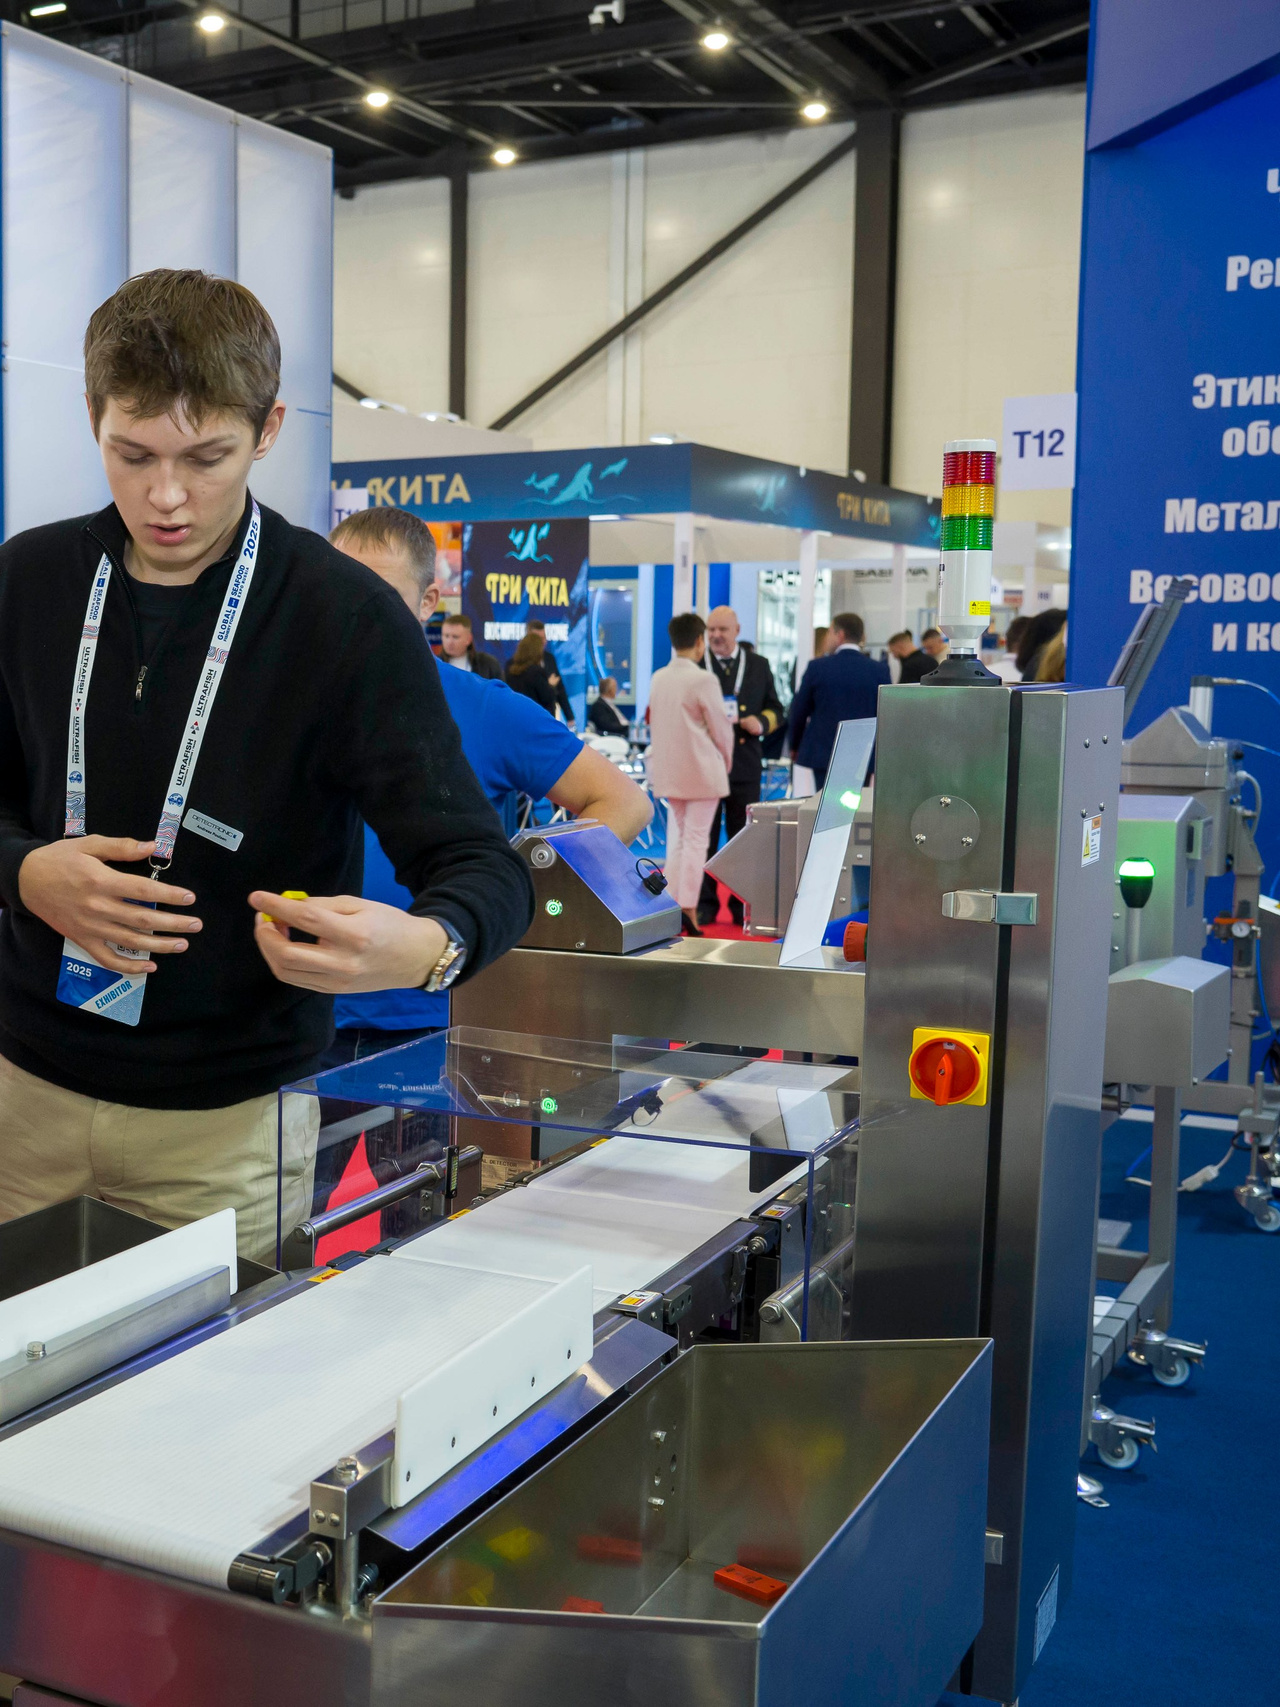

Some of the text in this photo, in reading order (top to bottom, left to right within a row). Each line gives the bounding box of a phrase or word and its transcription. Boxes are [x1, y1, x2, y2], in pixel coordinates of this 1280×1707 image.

[1226, 255, 1280, 292] Ре
[1013, 429, 1065, 458] T12
[243, 520, 259, 560] 2025
[231, 564, 246, 597] SEAFOOD
[485, 572, 570, 607] ТРИ КИТА
[92, 589, 104, 621] SEAFOOD
[217, 608, 233, 641] GLOBAL
[78, 646, 91, 694] ULTRAFISH
[194, 668, 215, 717] ULTRAFISH
[175, 738, 194, 786] ULTRAFISH
[66, 962, 92, 977] 2025
[94, 980, 133, 1009] EXHIBITOR
